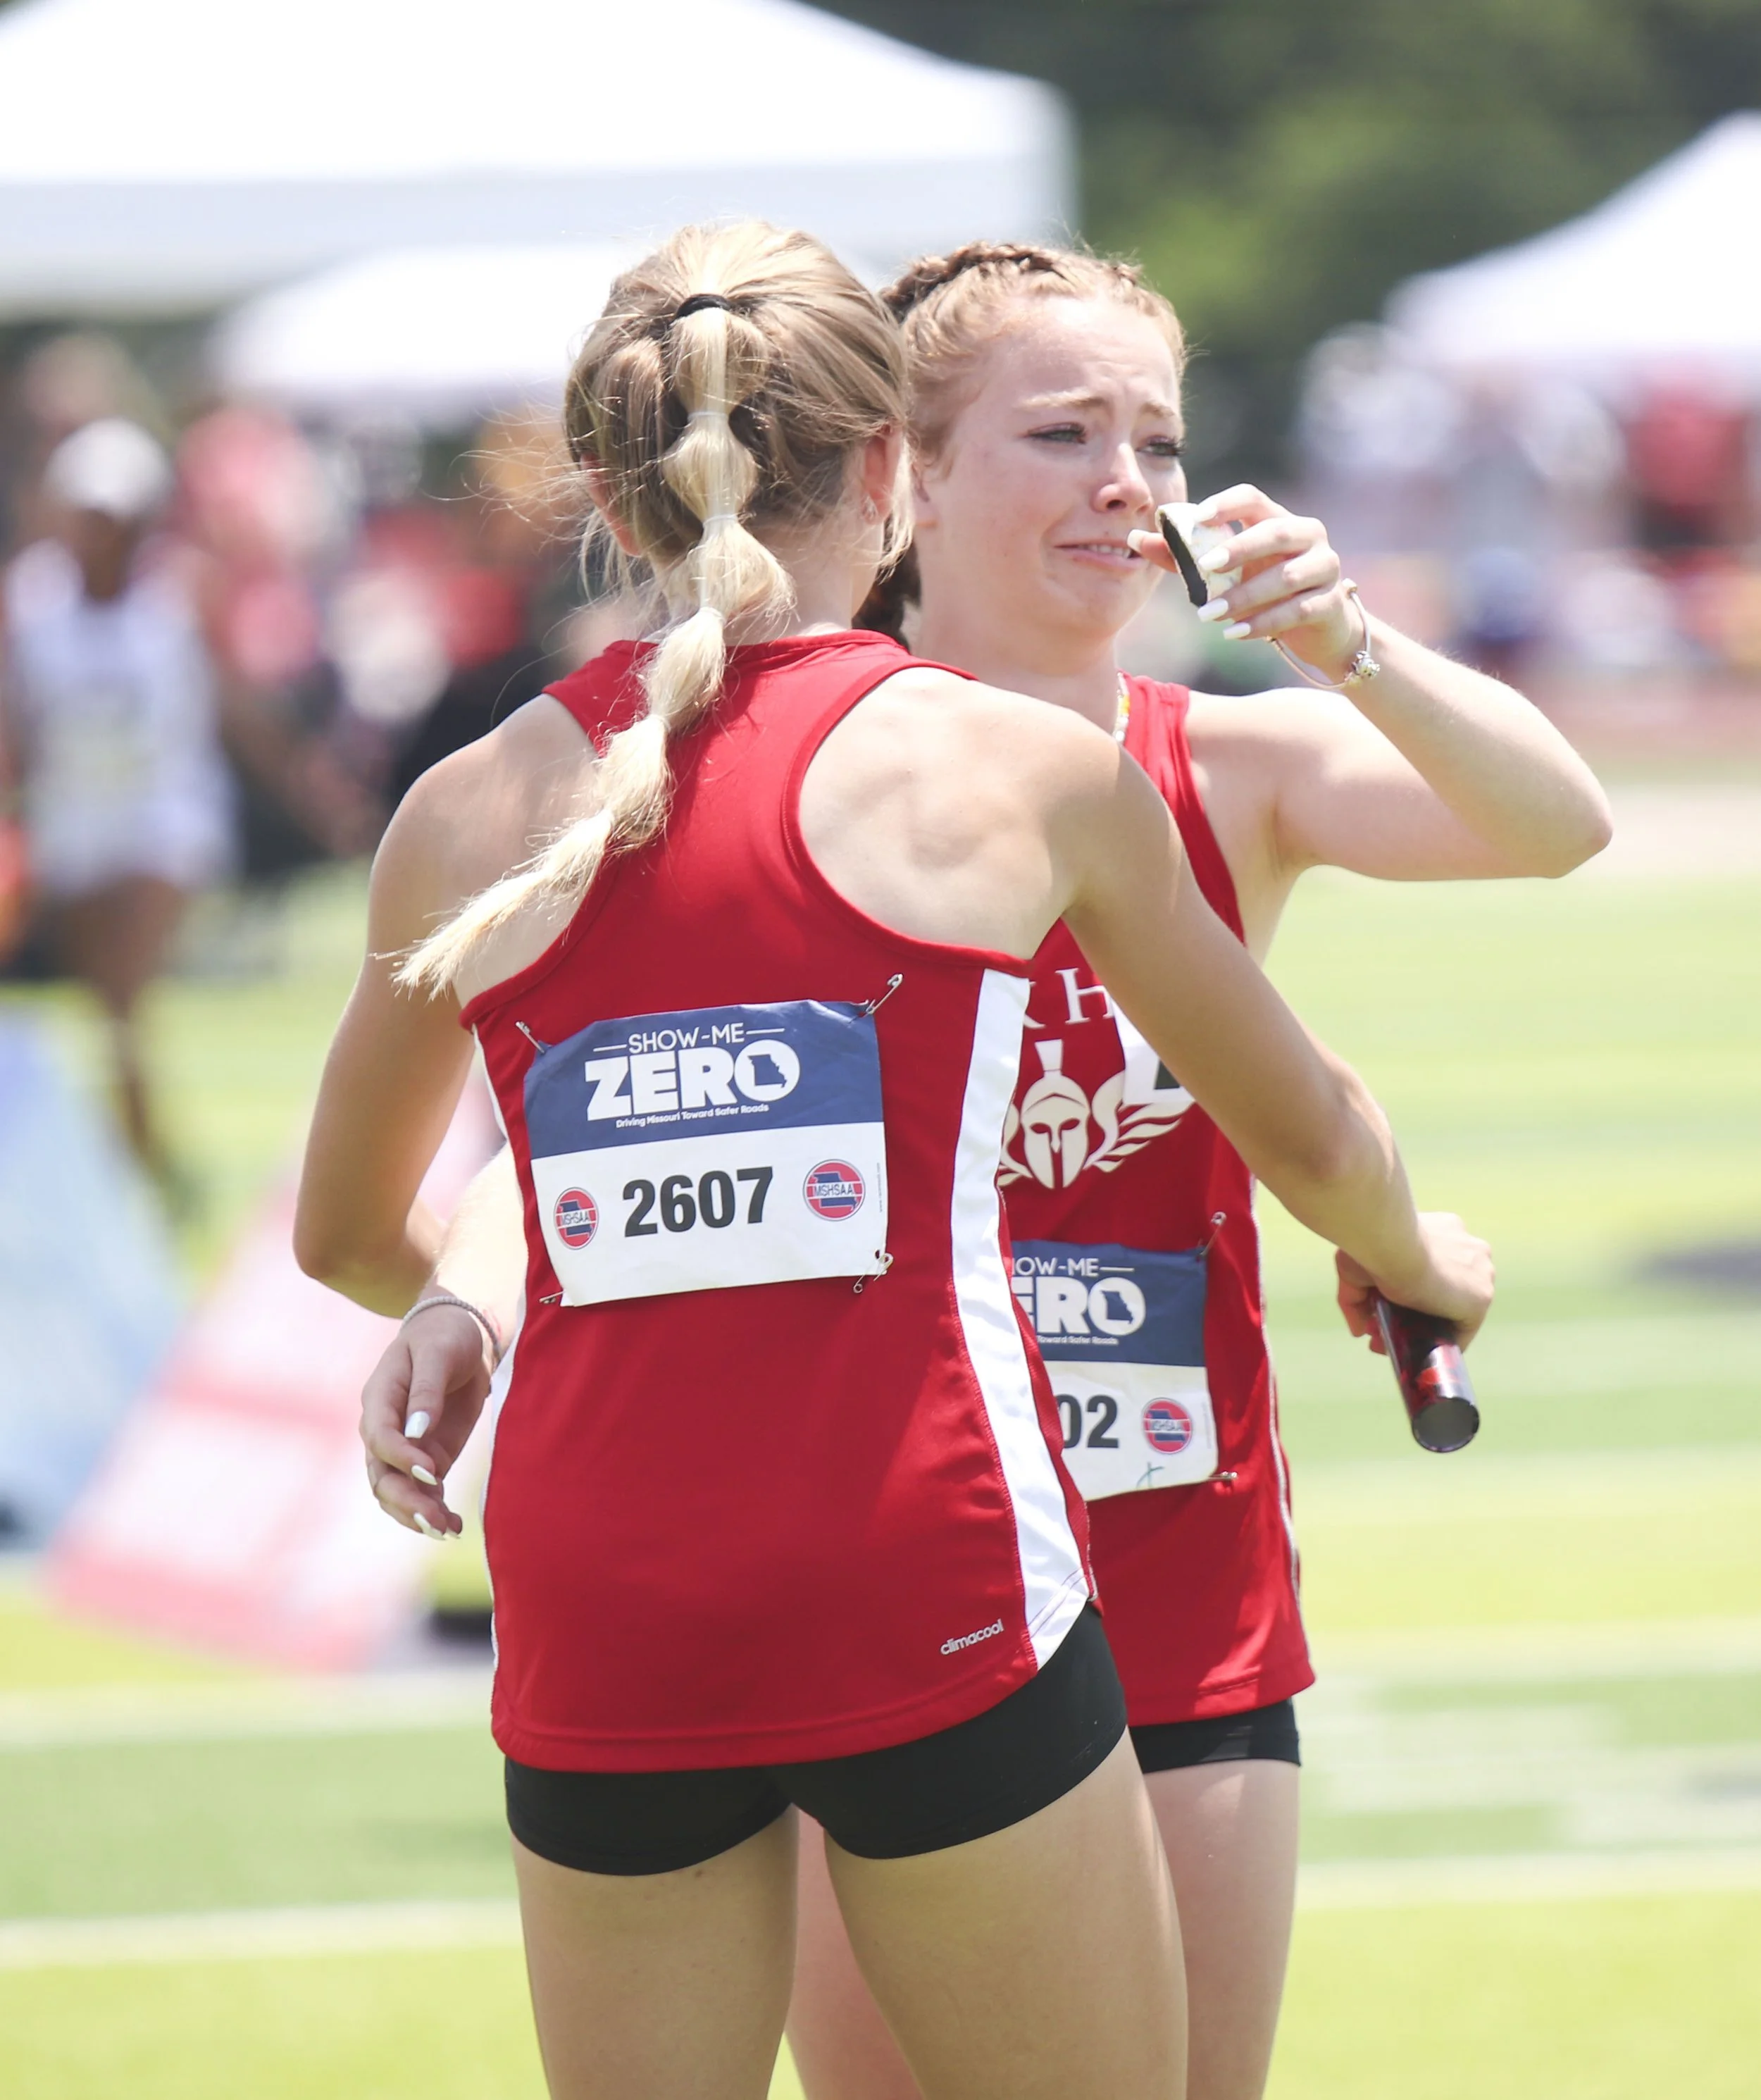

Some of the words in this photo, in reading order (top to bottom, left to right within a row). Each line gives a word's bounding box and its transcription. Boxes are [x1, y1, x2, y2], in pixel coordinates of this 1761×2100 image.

[628, 1022, 745, 1054] SHOW-ME
[584, 1038, 801, 1122] ZERO
[615, 1115, 646, 1129] Driving
[646, 1111, 681, 1125] Missouri
[681, 1108, 714, 1121] Toward
[714, 1105, 740, 1117] Safer
[740, 1102, 770, 1114] Roads
[622, 1166, 773, 1238] 2607
[814, 1183, 854, 1197] MSHSAA
[1012, 1256, 1100, 1277] OW-ME
[1055, 1393, 1119, 1449] 02
[940, 1617, 1004, 1655] climacool
